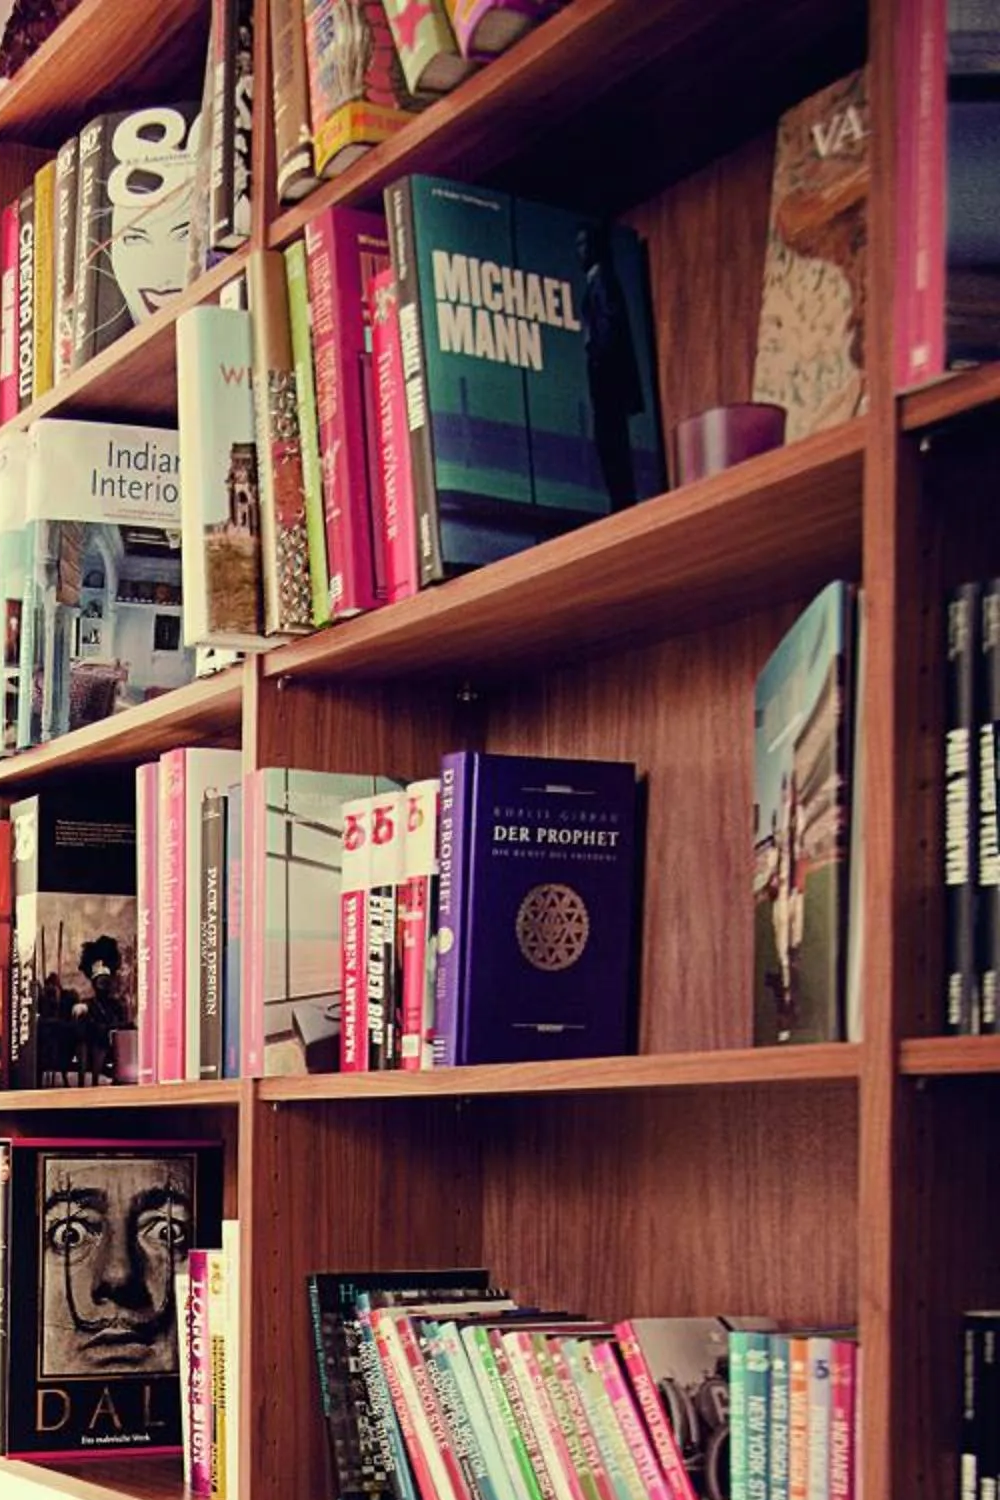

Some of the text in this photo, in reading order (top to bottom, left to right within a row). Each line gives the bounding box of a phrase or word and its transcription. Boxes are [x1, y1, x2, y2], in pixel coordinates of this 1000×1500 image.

[432, 249, 582, 332] MICHAEL
[436, 301, 543, 371] MANN
[440, 769, 456, 914] DER PROPHET
[494, 825, 620, 847] DER PROPHET
[205, 866, 218, 1017] PACKAGE DESIGN
[345, 897, 359, 1064] WOMEN ARTISTS
[428, 1411, 450, 1449] STYLE
[749, 1395, 765, 1433] NEW
[772, 1384, 787, 1416] WEB
[750, 1435, 766, 1475] YORK
[833, 1420, 849, 1496] INDIANER
